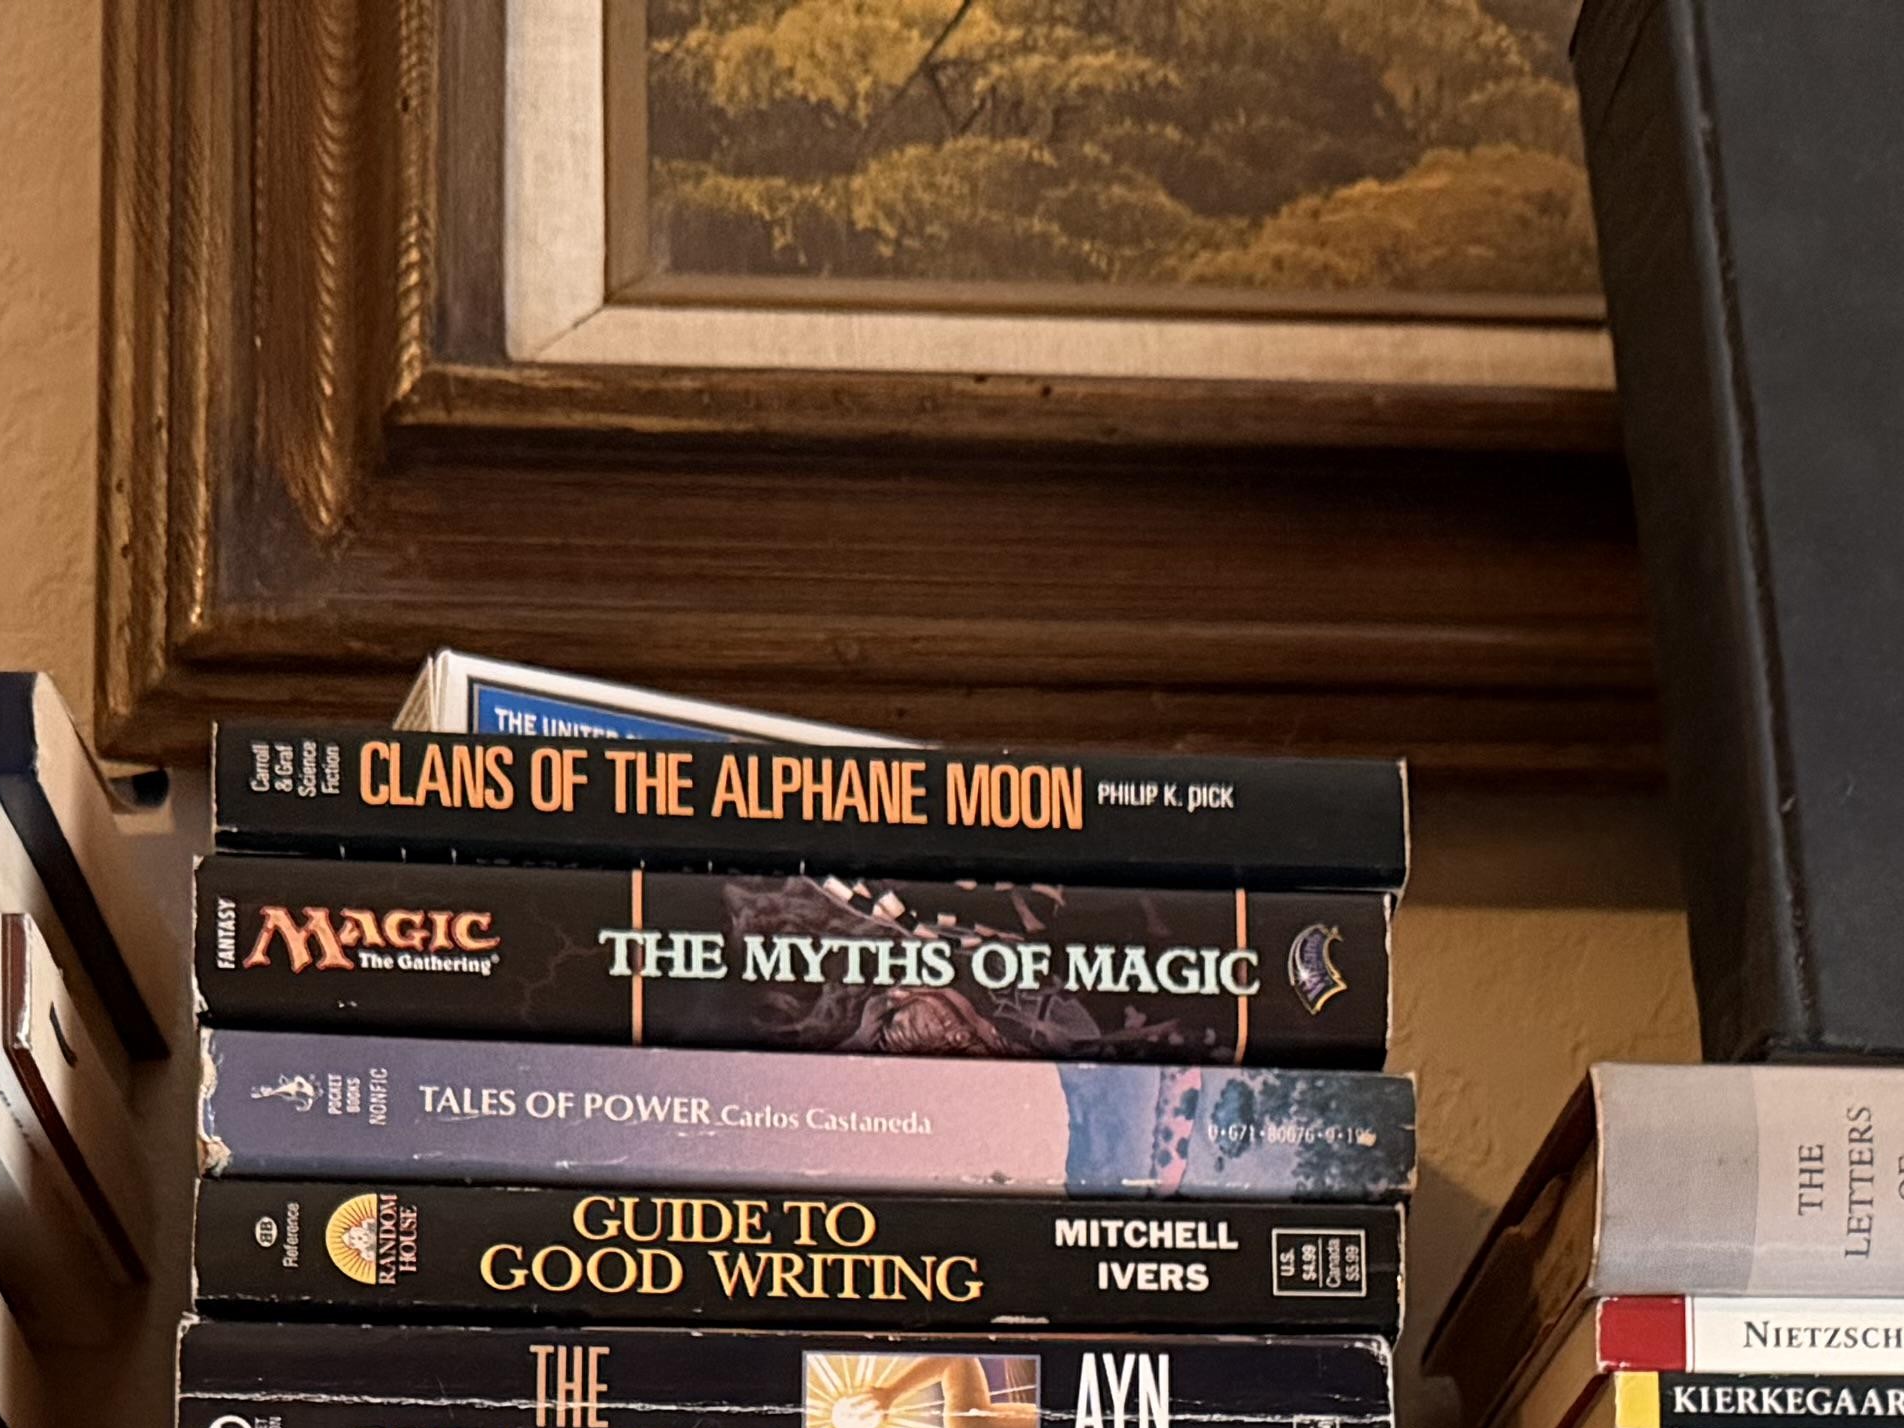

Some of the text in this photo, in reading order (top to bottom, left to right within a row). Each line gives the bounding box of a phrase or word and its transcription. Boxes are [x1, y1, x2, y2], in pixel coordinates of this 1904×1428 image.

[216, 897, 237, 969] FANTASY
[1797, 1143, 1824, 1217] THE
[1844, 1105, 1872, 1260] LETTERS
[284, 1202, 300, 1269] Reference
[379, 1193, 397, 1285] RANDOM
[399, 1205, 418, 1273] HOUSE
[573, 1196, 876, 1247] GUIDE TO
[1055, 1219, 1238, 1250] MITCHELL
[480, 1244, 984, 1302] GOOD WRITING
[1098, 1262, 1209, 1292] IVERS
